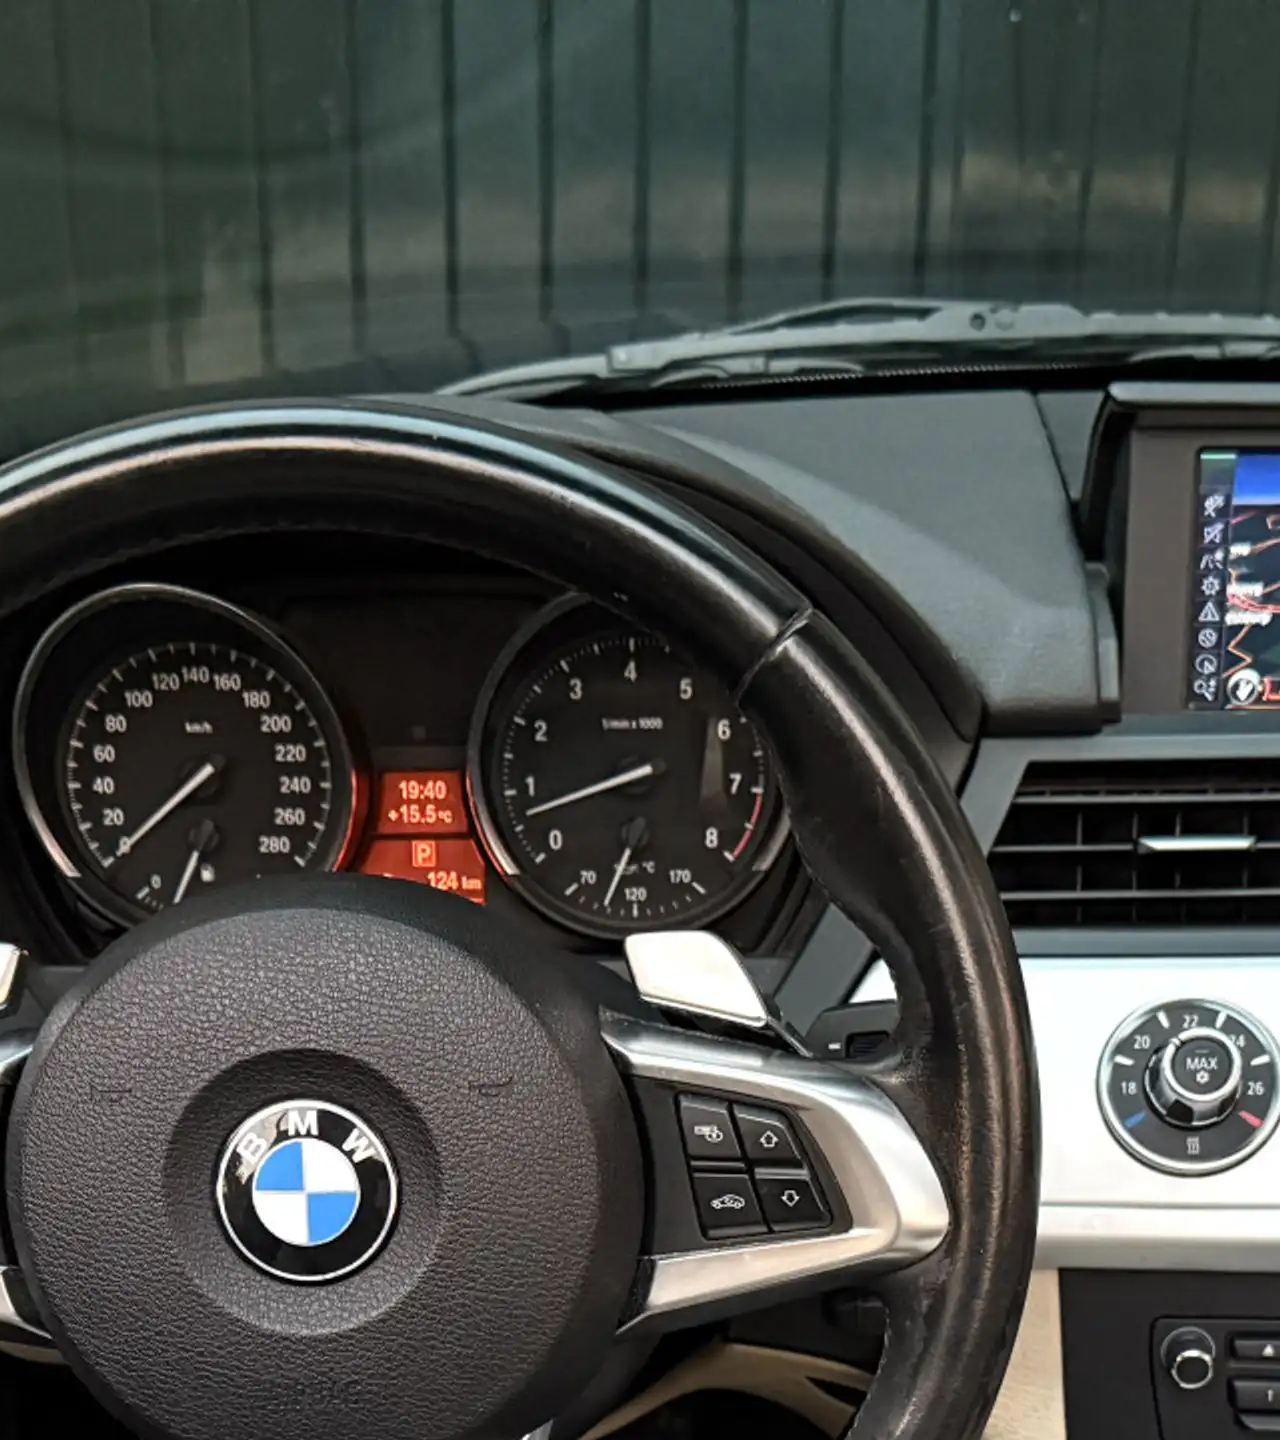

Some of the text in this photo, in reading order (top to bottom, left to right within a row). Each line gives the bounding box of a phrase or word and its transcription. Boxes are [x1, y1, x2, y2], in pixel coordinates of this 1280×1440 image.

[181, 665, 210, 684] 140
[624, 660, 638, 682] 4
[152, 673, 180, 691] 120
[213, 674, 242, 691] 160
[569, 678, 583, 700] 3
[679, 678, 693, 700] 5
[124, 691, 153, 708] 100
[242, 691, 271, 708] 180
[105, 715, 127, 733] 80
[185, 720, 214, 735] km/h
[260, 715, 292, 732] 200
[533, 721, 549, 742] 2
[717, 718, 731, 741] 6
[93, 745, 116, 763] 60
[275, 745, 307, 762] 220
[93, 777, 115, 794] 40
[279, 777, 312, 793] 240
[398, 780, 448, 800] 19:40
[525, 776, 536, 796] 1
[729, 773, 743, 794] 7
[103, 808, 125, 826] 20
[274, 808, 306, 825] 260
[259, 836, 291, 855] 280
[548, 829, 563, 850] 0
[704, 827, 719, 848] 8
[427, 871, 482, 891] 124 km
[579, 869, 597, 885] 70
[669, 869, 692, 884] 170
[624, 887, 648, 902] 120
[1182, 1014, 1199, 1028] 22
[1133, 1034, 1151, 1050] 20
[1186, 1056, 1218, 1072] MAX
[1120, 1081, 1137, 1096] 18
[1247, 1081, 1265, 1096] 26
[235, 1109, 378, 1166] BMW
[1267, 1388, 1274, 1402] 1
